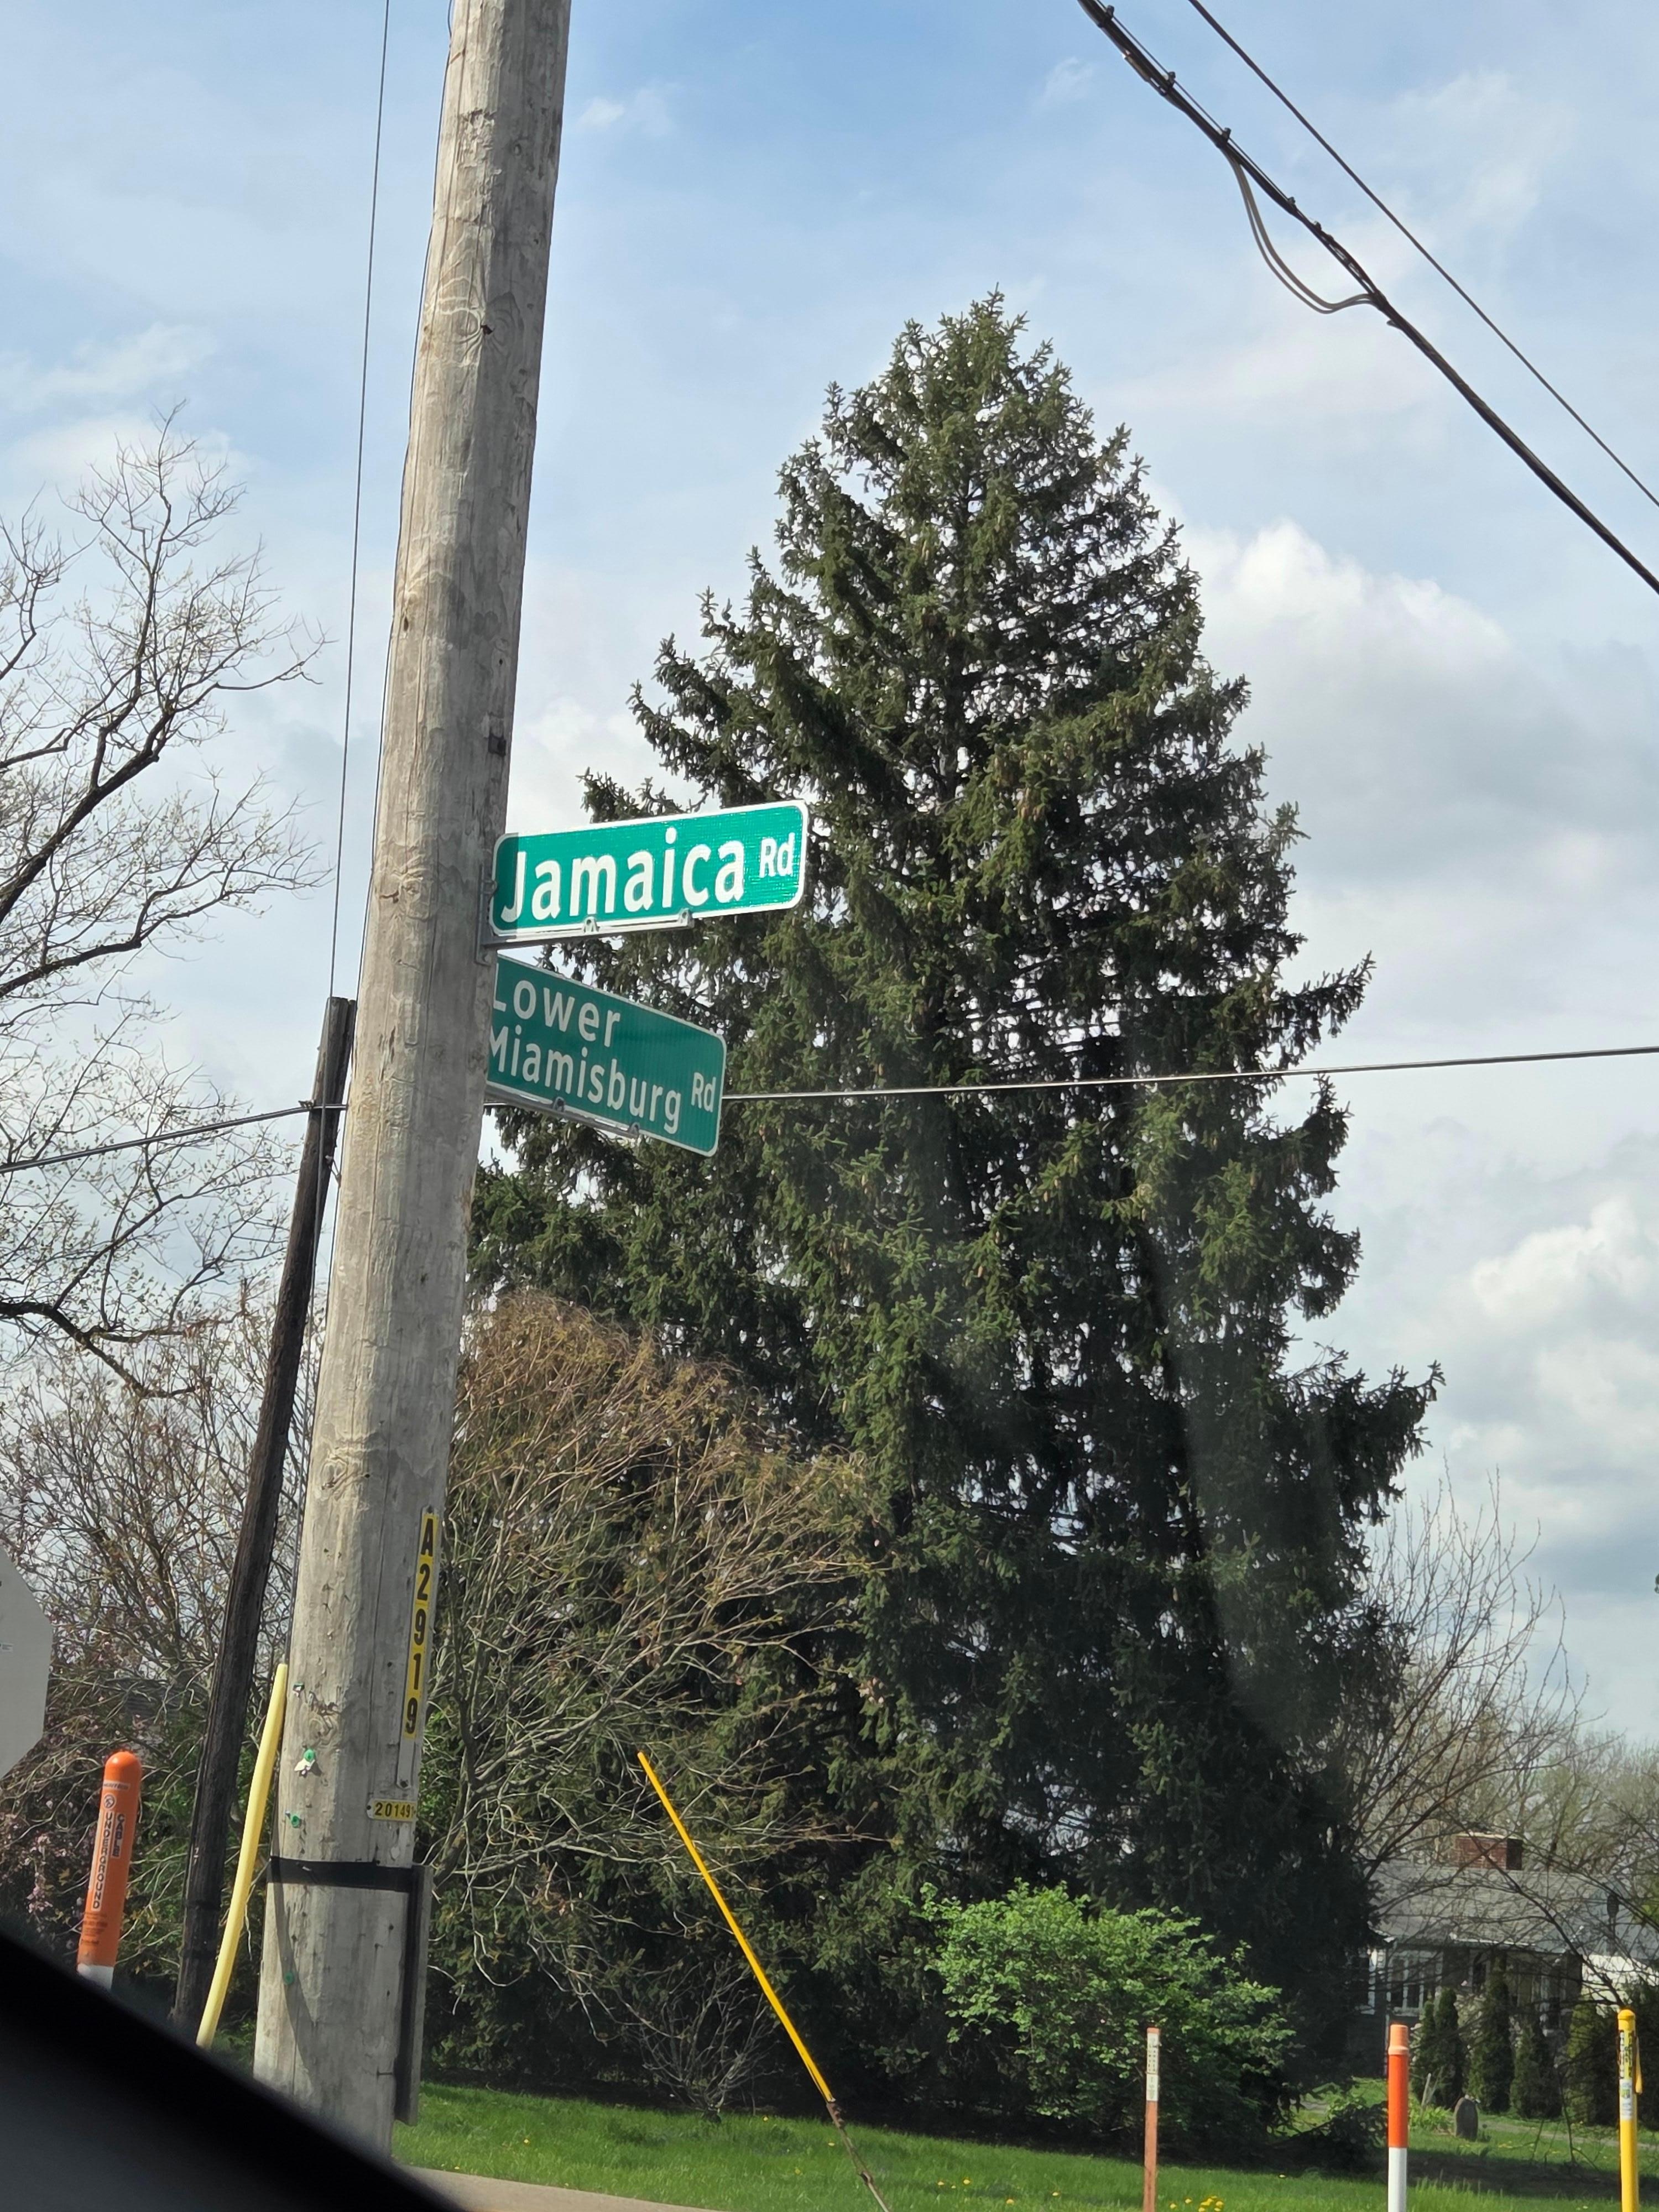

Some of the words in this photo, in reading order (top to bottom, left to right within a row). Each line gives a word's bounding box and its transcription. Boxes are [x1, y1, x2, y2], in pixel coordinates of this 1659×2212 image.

[500, 827, 745, 921] Jamaica
[759, 832, 795, 878] Rd
[493, 963, 620, 1047] Lower
[489, 1024, 681, 1134] Miamisburg
[691, 1072, 716, 1113] Rd
[404, 1519, 433, 1735] A29119
[92, 1812, 113, 1909] UNDERGROUND
[112, 1813, 125, 1857] CABLE
